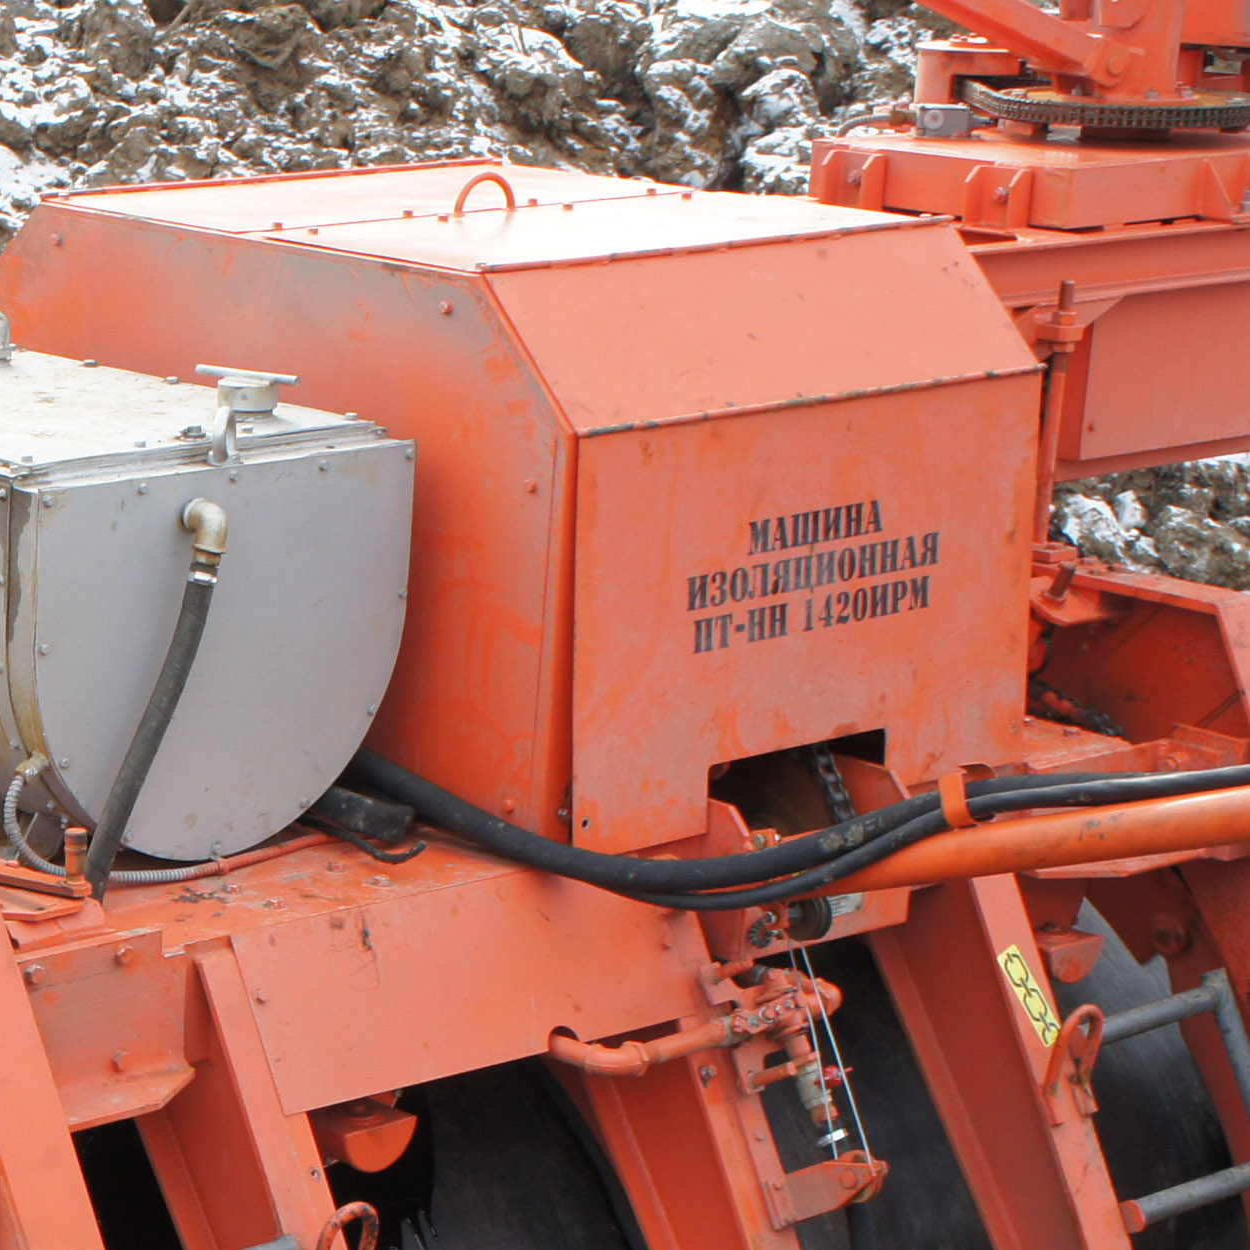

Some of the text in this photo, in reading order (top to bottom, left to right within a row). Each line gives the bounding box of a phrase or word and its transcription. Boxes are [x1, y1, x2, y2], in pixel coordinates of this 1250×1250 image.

[748, 500, 883, 556] МАШИНА
[687, 531, 940, 611] ИЗОЛЯЦИОННАЯ
[694, 603, 789, 654] ПТ-НН
